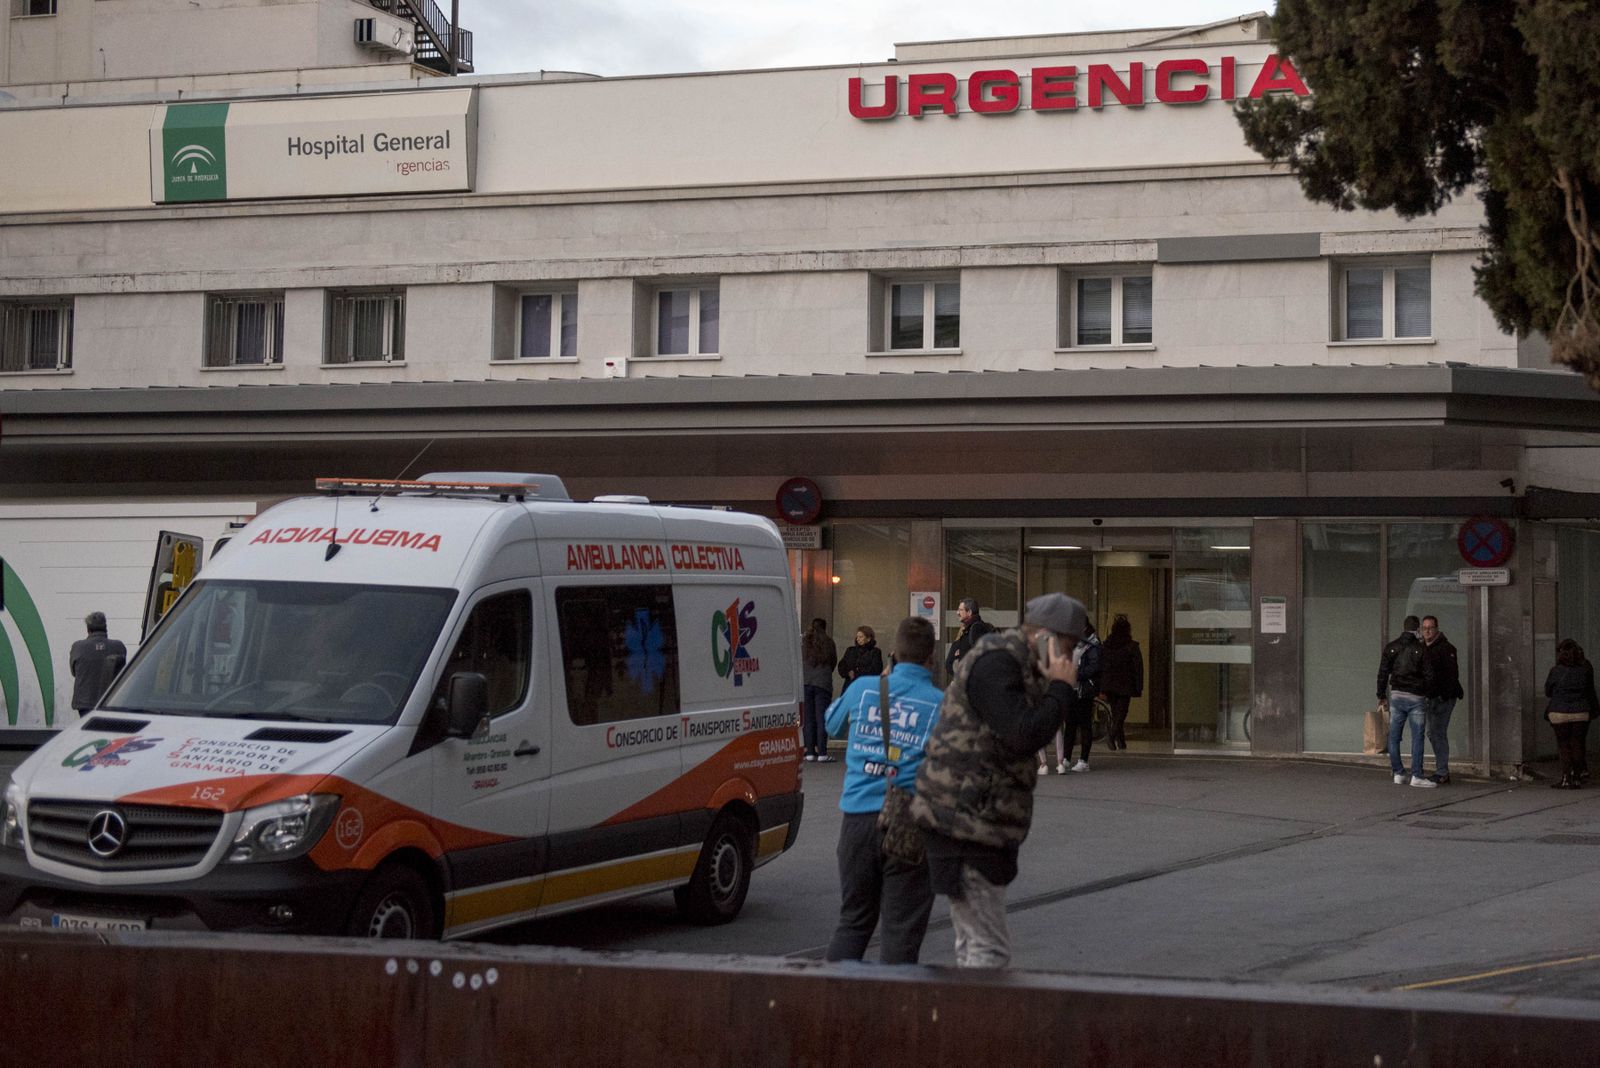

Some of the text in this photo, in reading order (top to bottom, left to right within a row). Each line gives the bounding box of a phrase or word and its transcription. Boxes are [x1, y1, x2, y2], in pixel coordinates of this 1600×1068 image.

[288, 130, 450, 160] Hospital General
[388, 158, 450, 176] rgencias
[566, 544, 745, 571] AMBULANCIA COLECTIVA
[733, 657, 760, 673] GRANADA
[606, 711, 797, 749] CONSORCIO DE TRANSPORTE SANITARIO DE
[178, 744, 289, 764] TRANSPORTE
[184, 737, 298, 756] CONSORCIO DE
[758, 737, 796, 756] GRANADA
[167, 751, 280, 773] SANITARIO DE
[170, 760, 247, 777] GRANADA
[864, 761, 886, 775] elf
[190, 786, 225, 801] 162
[339, 818, 361, 838] 162
